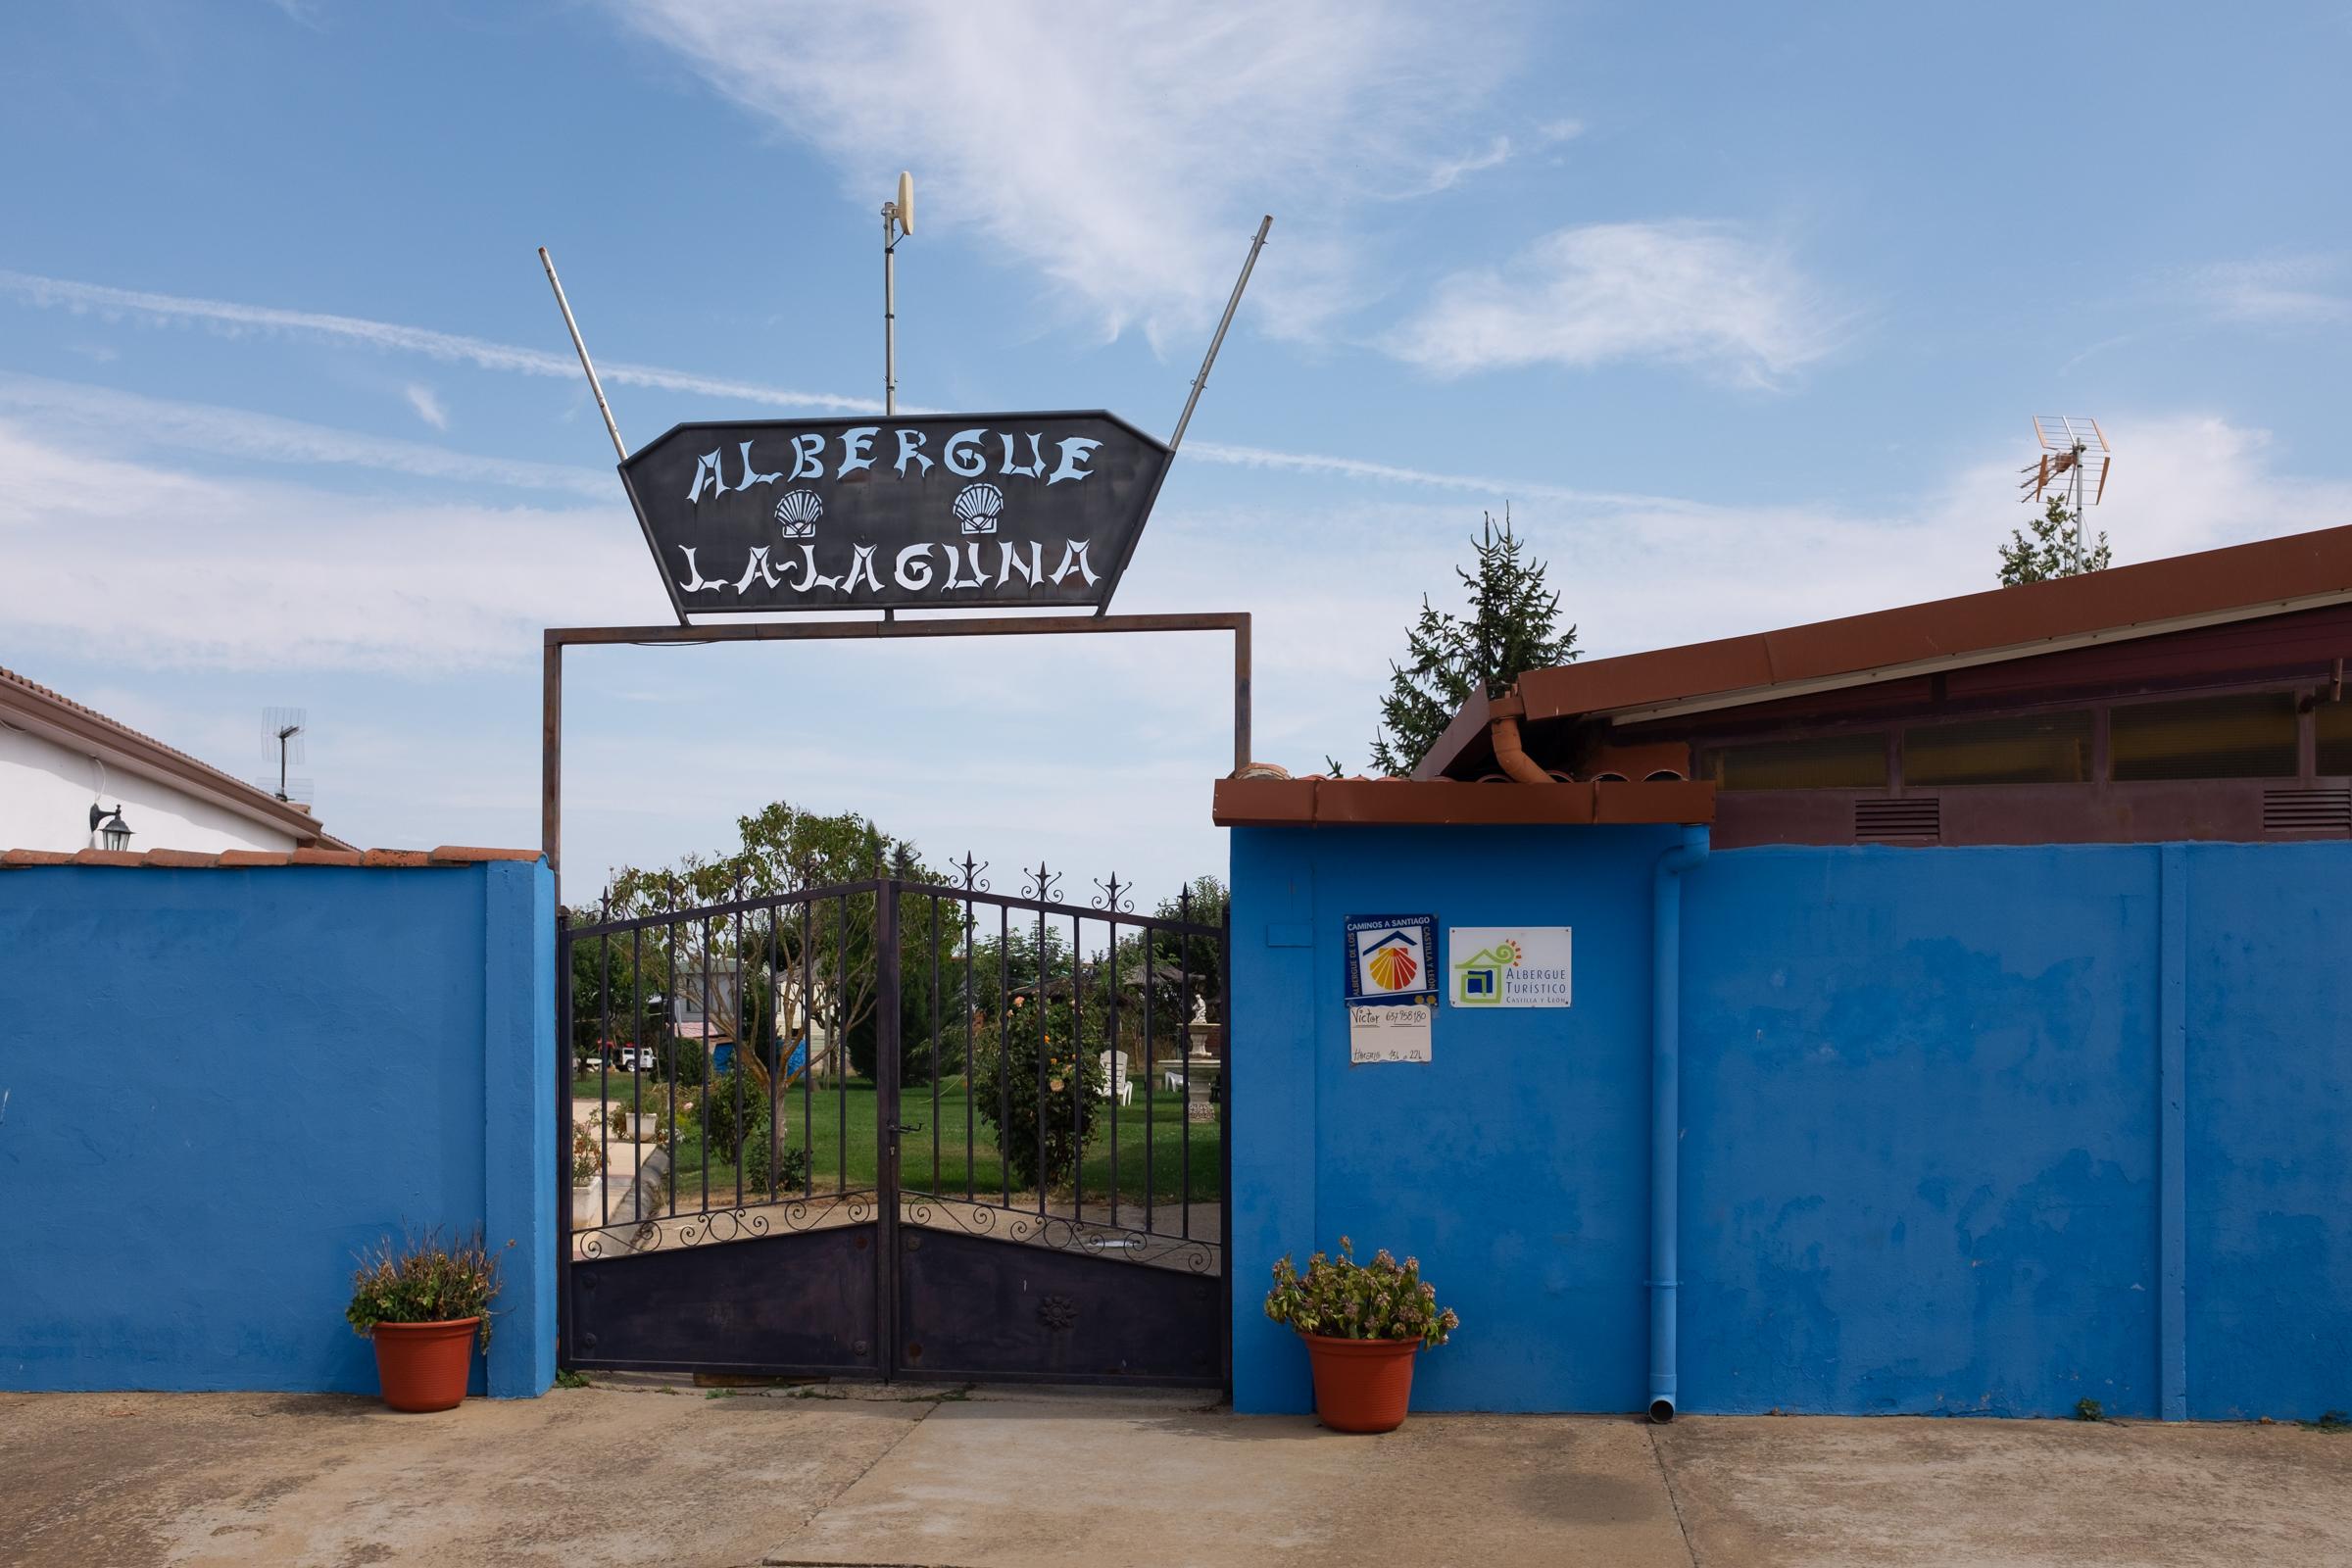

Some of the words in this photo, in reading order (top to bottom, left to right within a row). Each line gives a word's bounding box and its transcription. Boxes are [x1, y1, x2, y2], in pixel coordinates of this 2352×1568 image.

[687, 426, 1103, 504] ALBERGUE
[1347, 921, 1383, 931] CAMINOS
[1392, 916, 1430, 927] SANTIAGO
[1349, 948, 1356, 958] DE
[1423, 926, 1434, 961] CASTILLA
[1350, 960, 1360, 997] ALBERGUE
[1506, 967, 1566, 980] ALBERGUE
